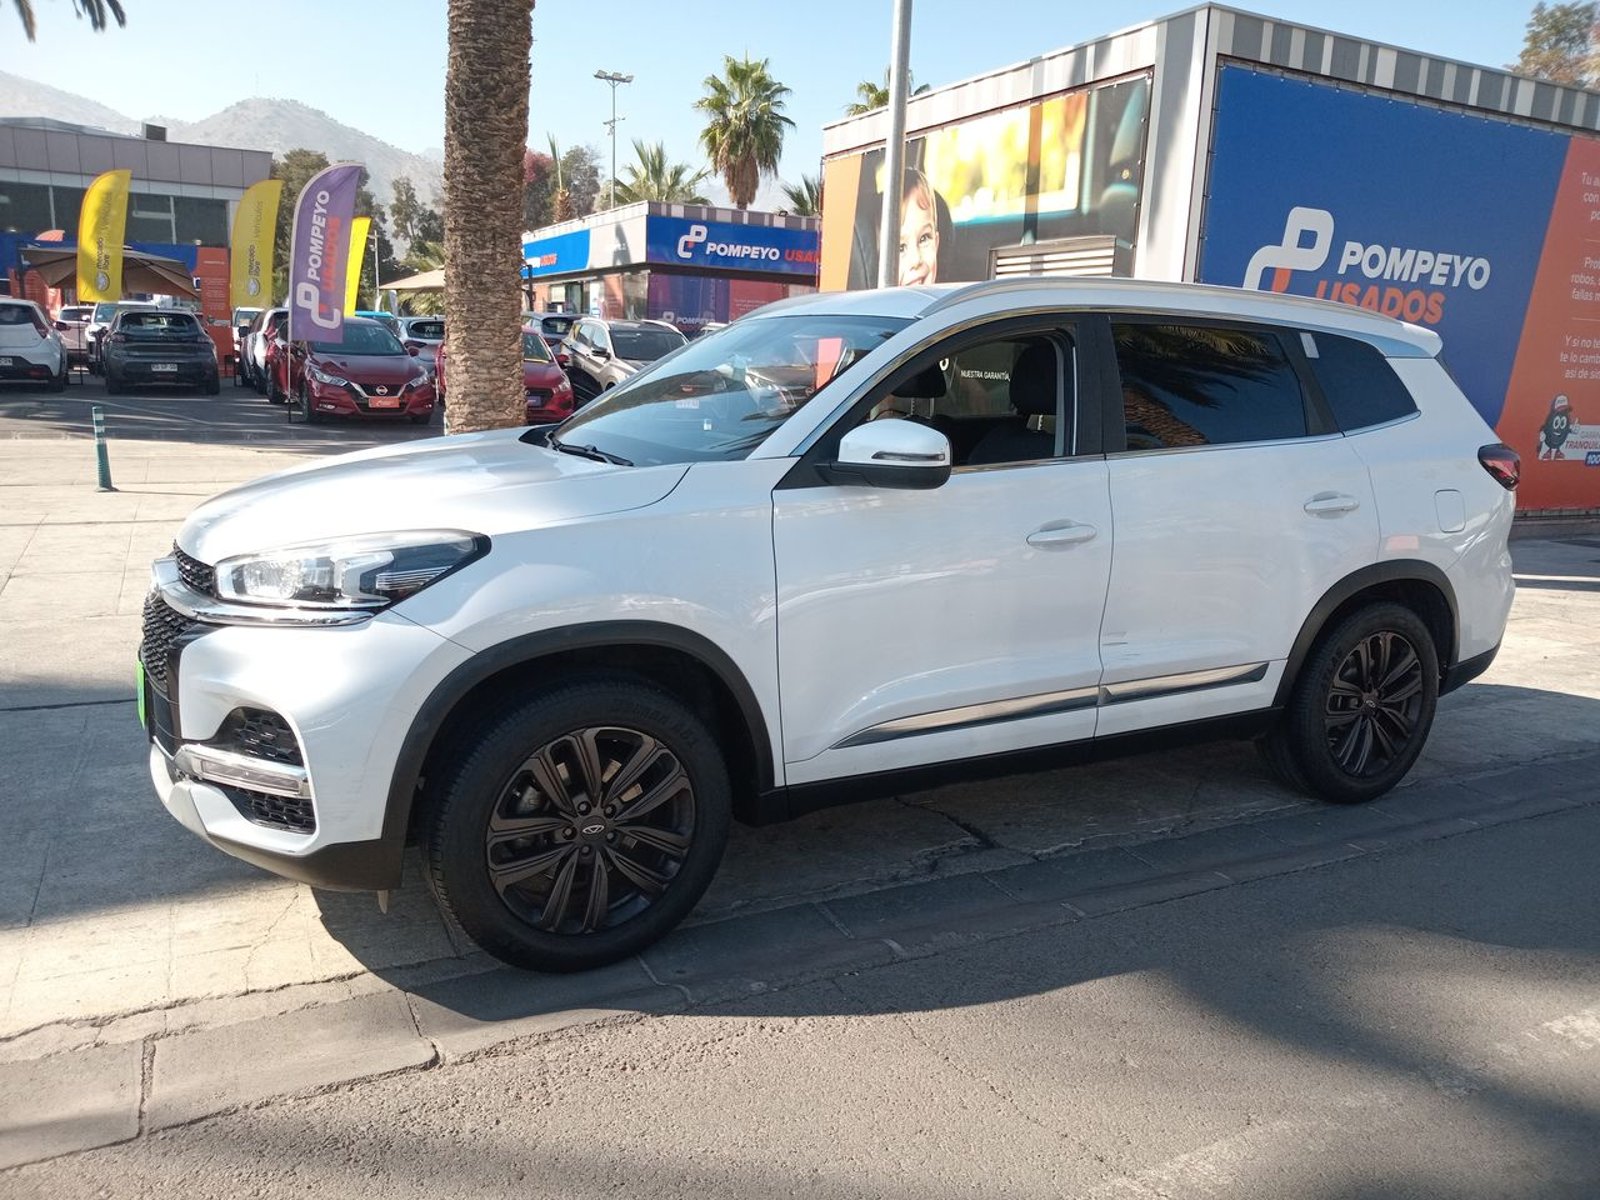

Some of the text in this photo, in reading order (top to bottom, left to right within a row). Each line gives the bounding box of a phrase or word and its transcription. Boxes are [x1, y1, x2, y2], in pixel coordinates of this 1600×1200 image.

[1582, 172, 1592, 185] Tu
[1583, 192, 1599, 203] con
[308, 190, 330, 281] POMPEYO
[705, 242, 780, 261] POMPEYO
[1338, 241, 1491, 290] POMPEYO
[1316, 280, 1446, 325] USADOS
[1581, 339, 1592, 348] no
[1560, 351, 1569, 362] te
[960, 370, 983, 379] NUESTRA
